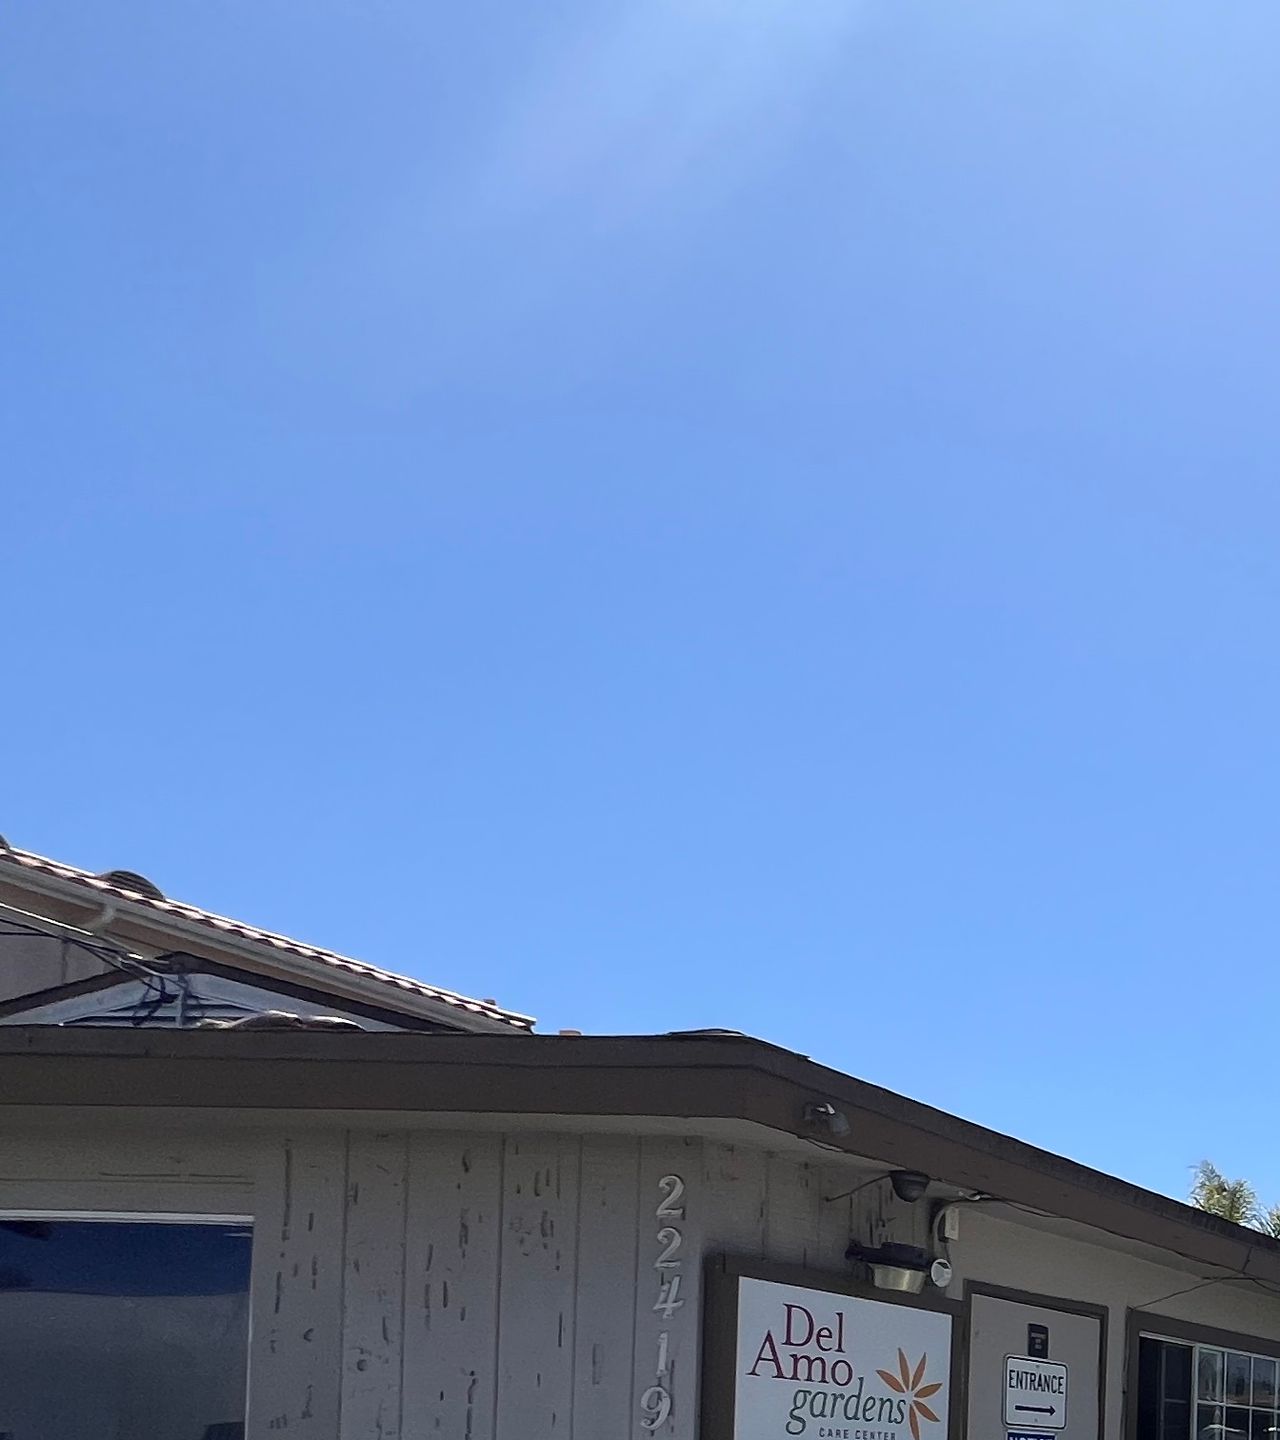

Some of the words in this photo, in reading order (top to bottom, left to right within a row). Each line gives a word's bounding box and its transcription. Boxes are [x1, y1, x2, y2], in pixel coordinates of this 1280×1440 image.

[640, 1175, 685, 1431] 22419
[781, 1303, 846, 1353] Del
[745, 1330, 854, 1387] Amo
[1009, 1369, 1064, 1395] ENTRANCE
[785, 1377, 907, 1435] gardens
[819, 1427, 850, 1440] CARE
